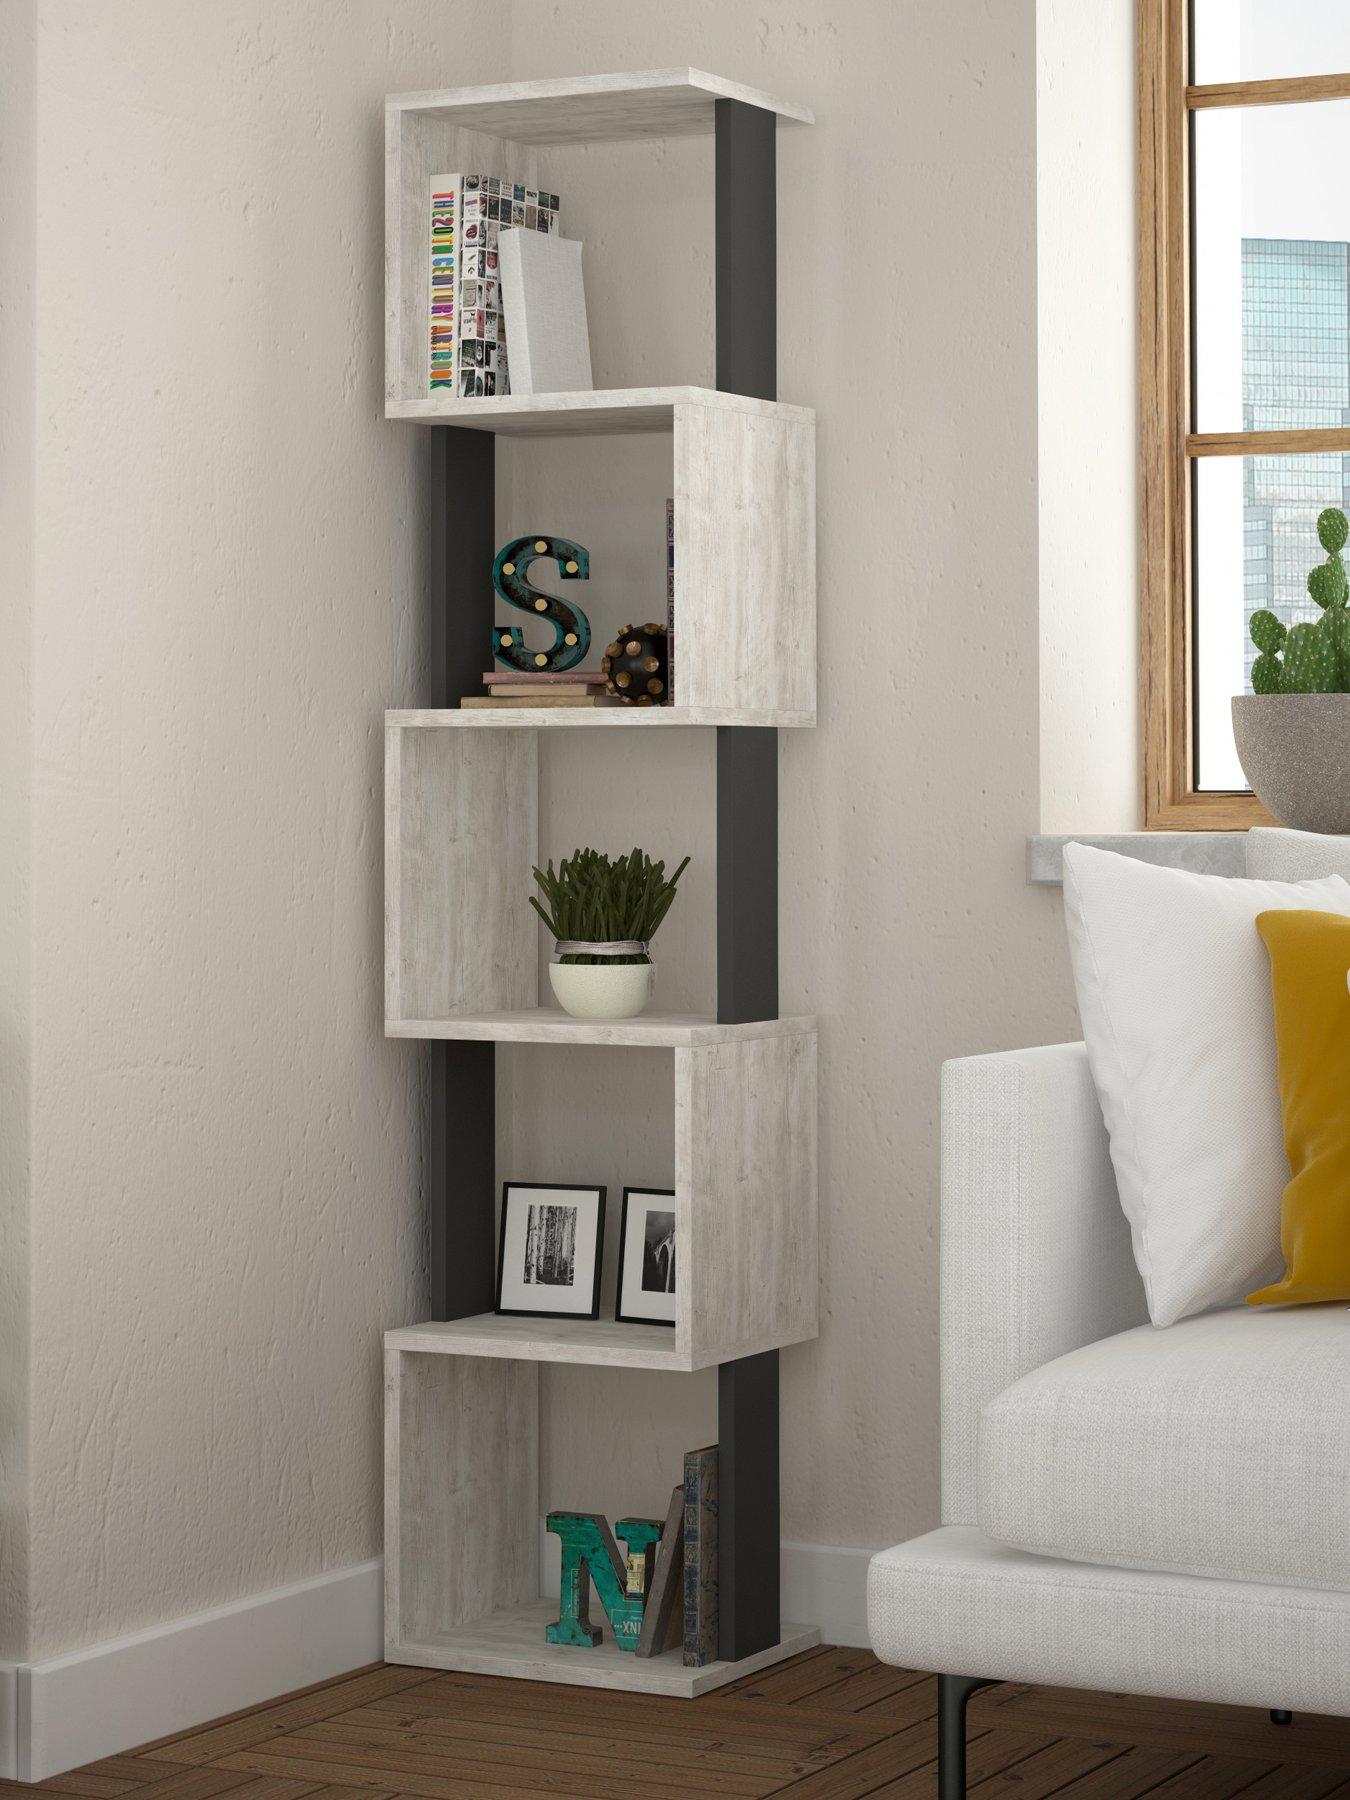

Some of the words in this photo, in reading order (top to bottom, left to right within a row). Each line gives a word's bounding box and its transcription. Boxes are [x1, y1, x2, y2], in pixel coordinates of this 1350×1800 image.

[431, 257, 454, 322] CENTURY
[492, 535, 592, 673] S
[546, 1511, 666, 1652] N
